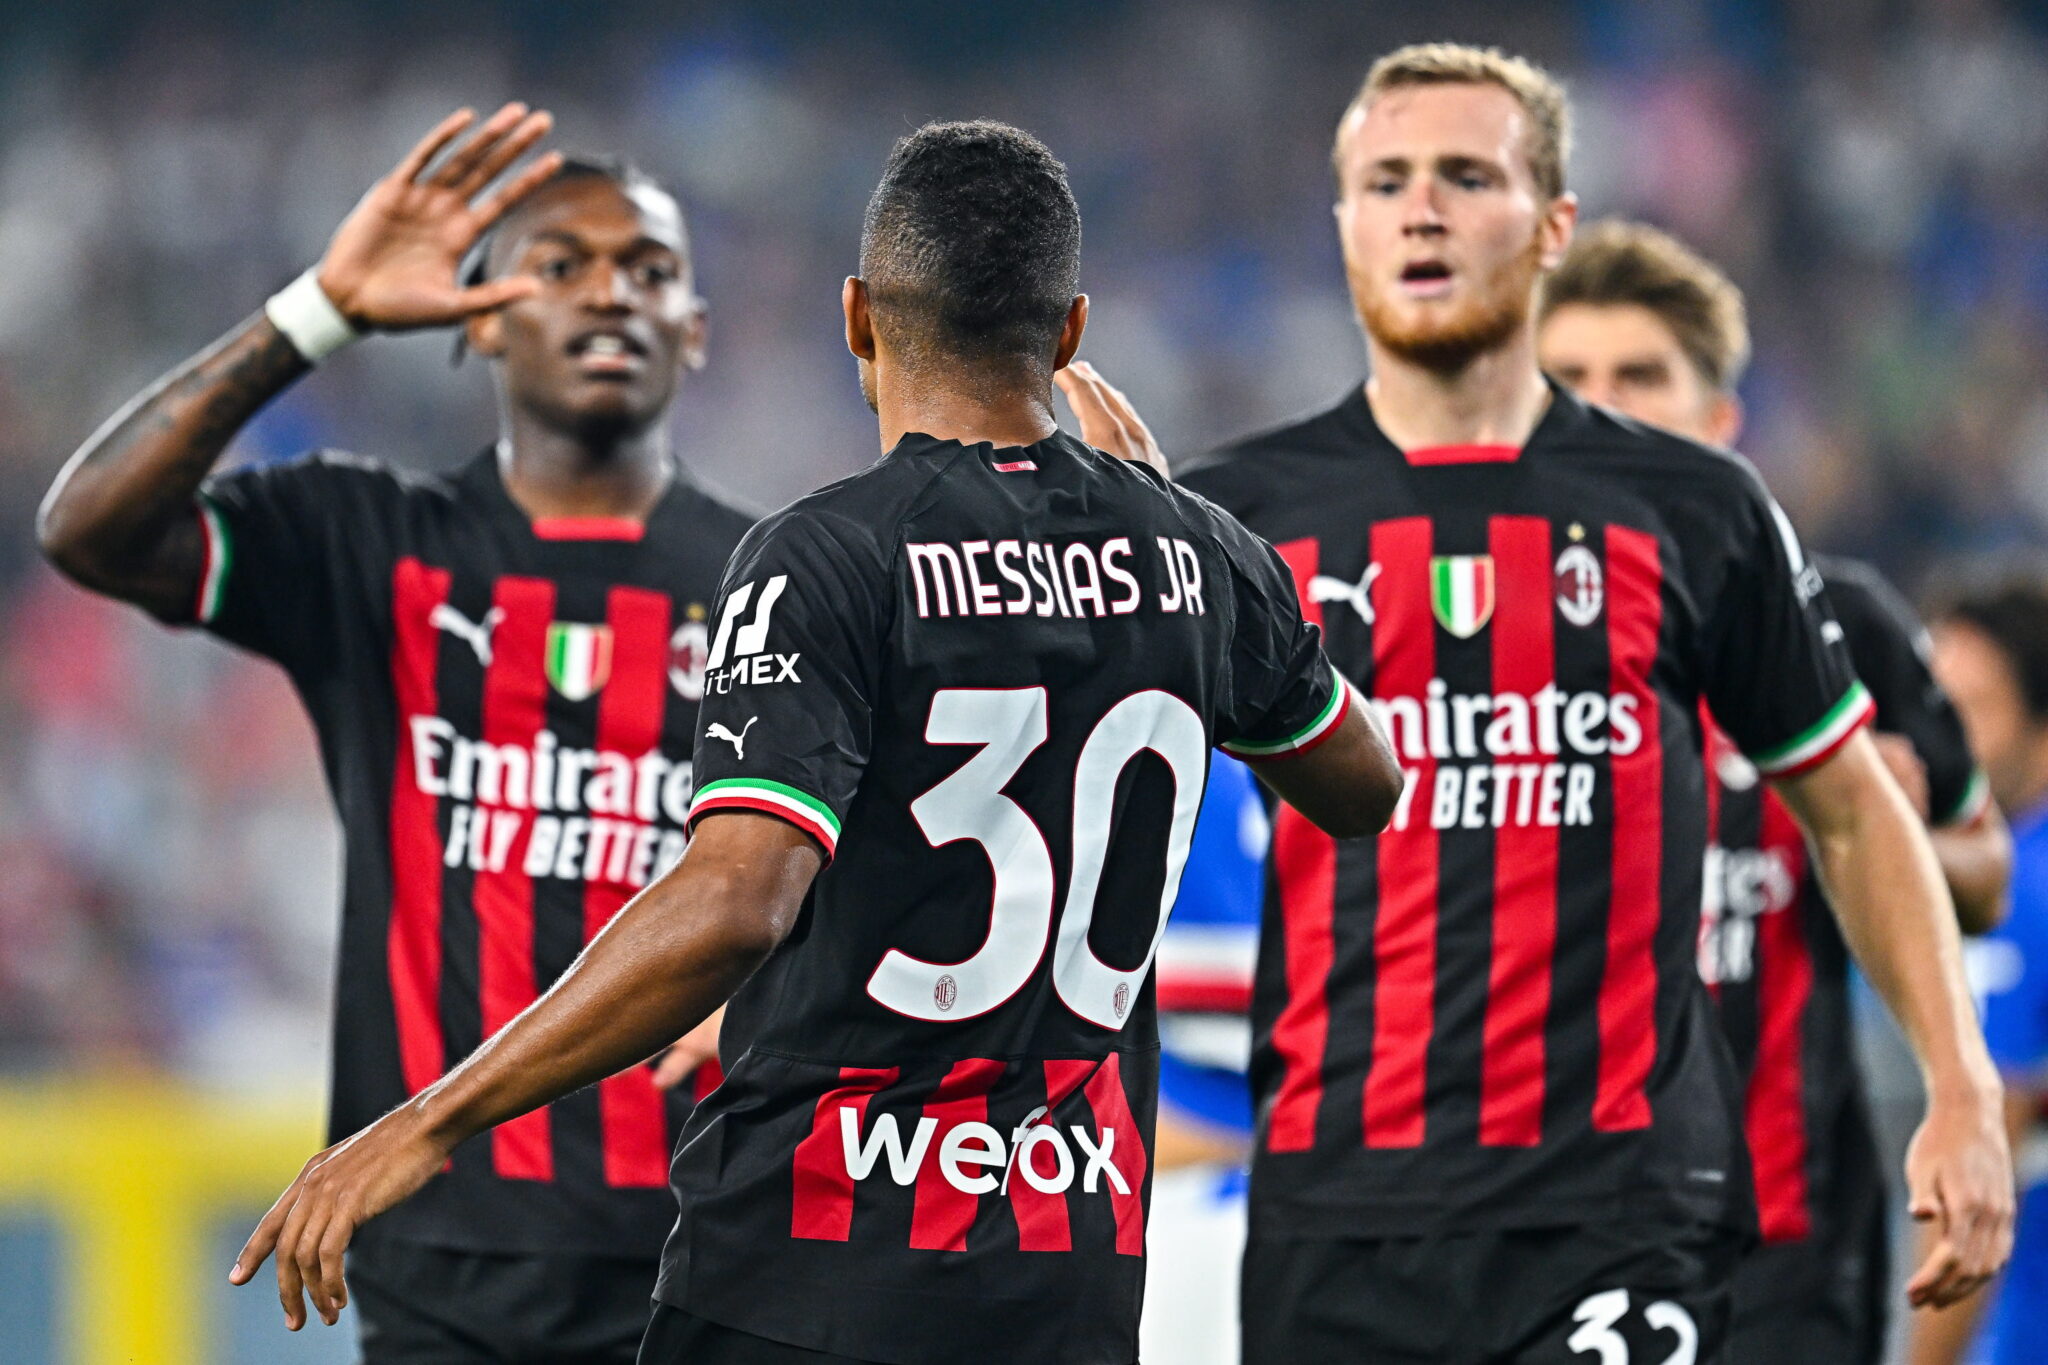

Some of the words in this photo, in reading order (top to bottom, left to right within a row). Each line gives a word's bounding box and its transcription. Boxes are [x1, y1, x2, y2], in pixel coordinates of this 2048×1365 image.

[906, 537, 1141, 619] MESSIAS
[1156, 536, 1205, 616] JR
[705, 652, 802, 696] itMEX
[1370, 678, 1643, 760] mirates
[410, 713, 693, 824] Emirate
[1430, 762, 1596, 830] BETTER
[444, 805, 523, 873] FLY
[865, 685, 1206, 1032] 30
[839, 1105, 1132, 1196] wefox
